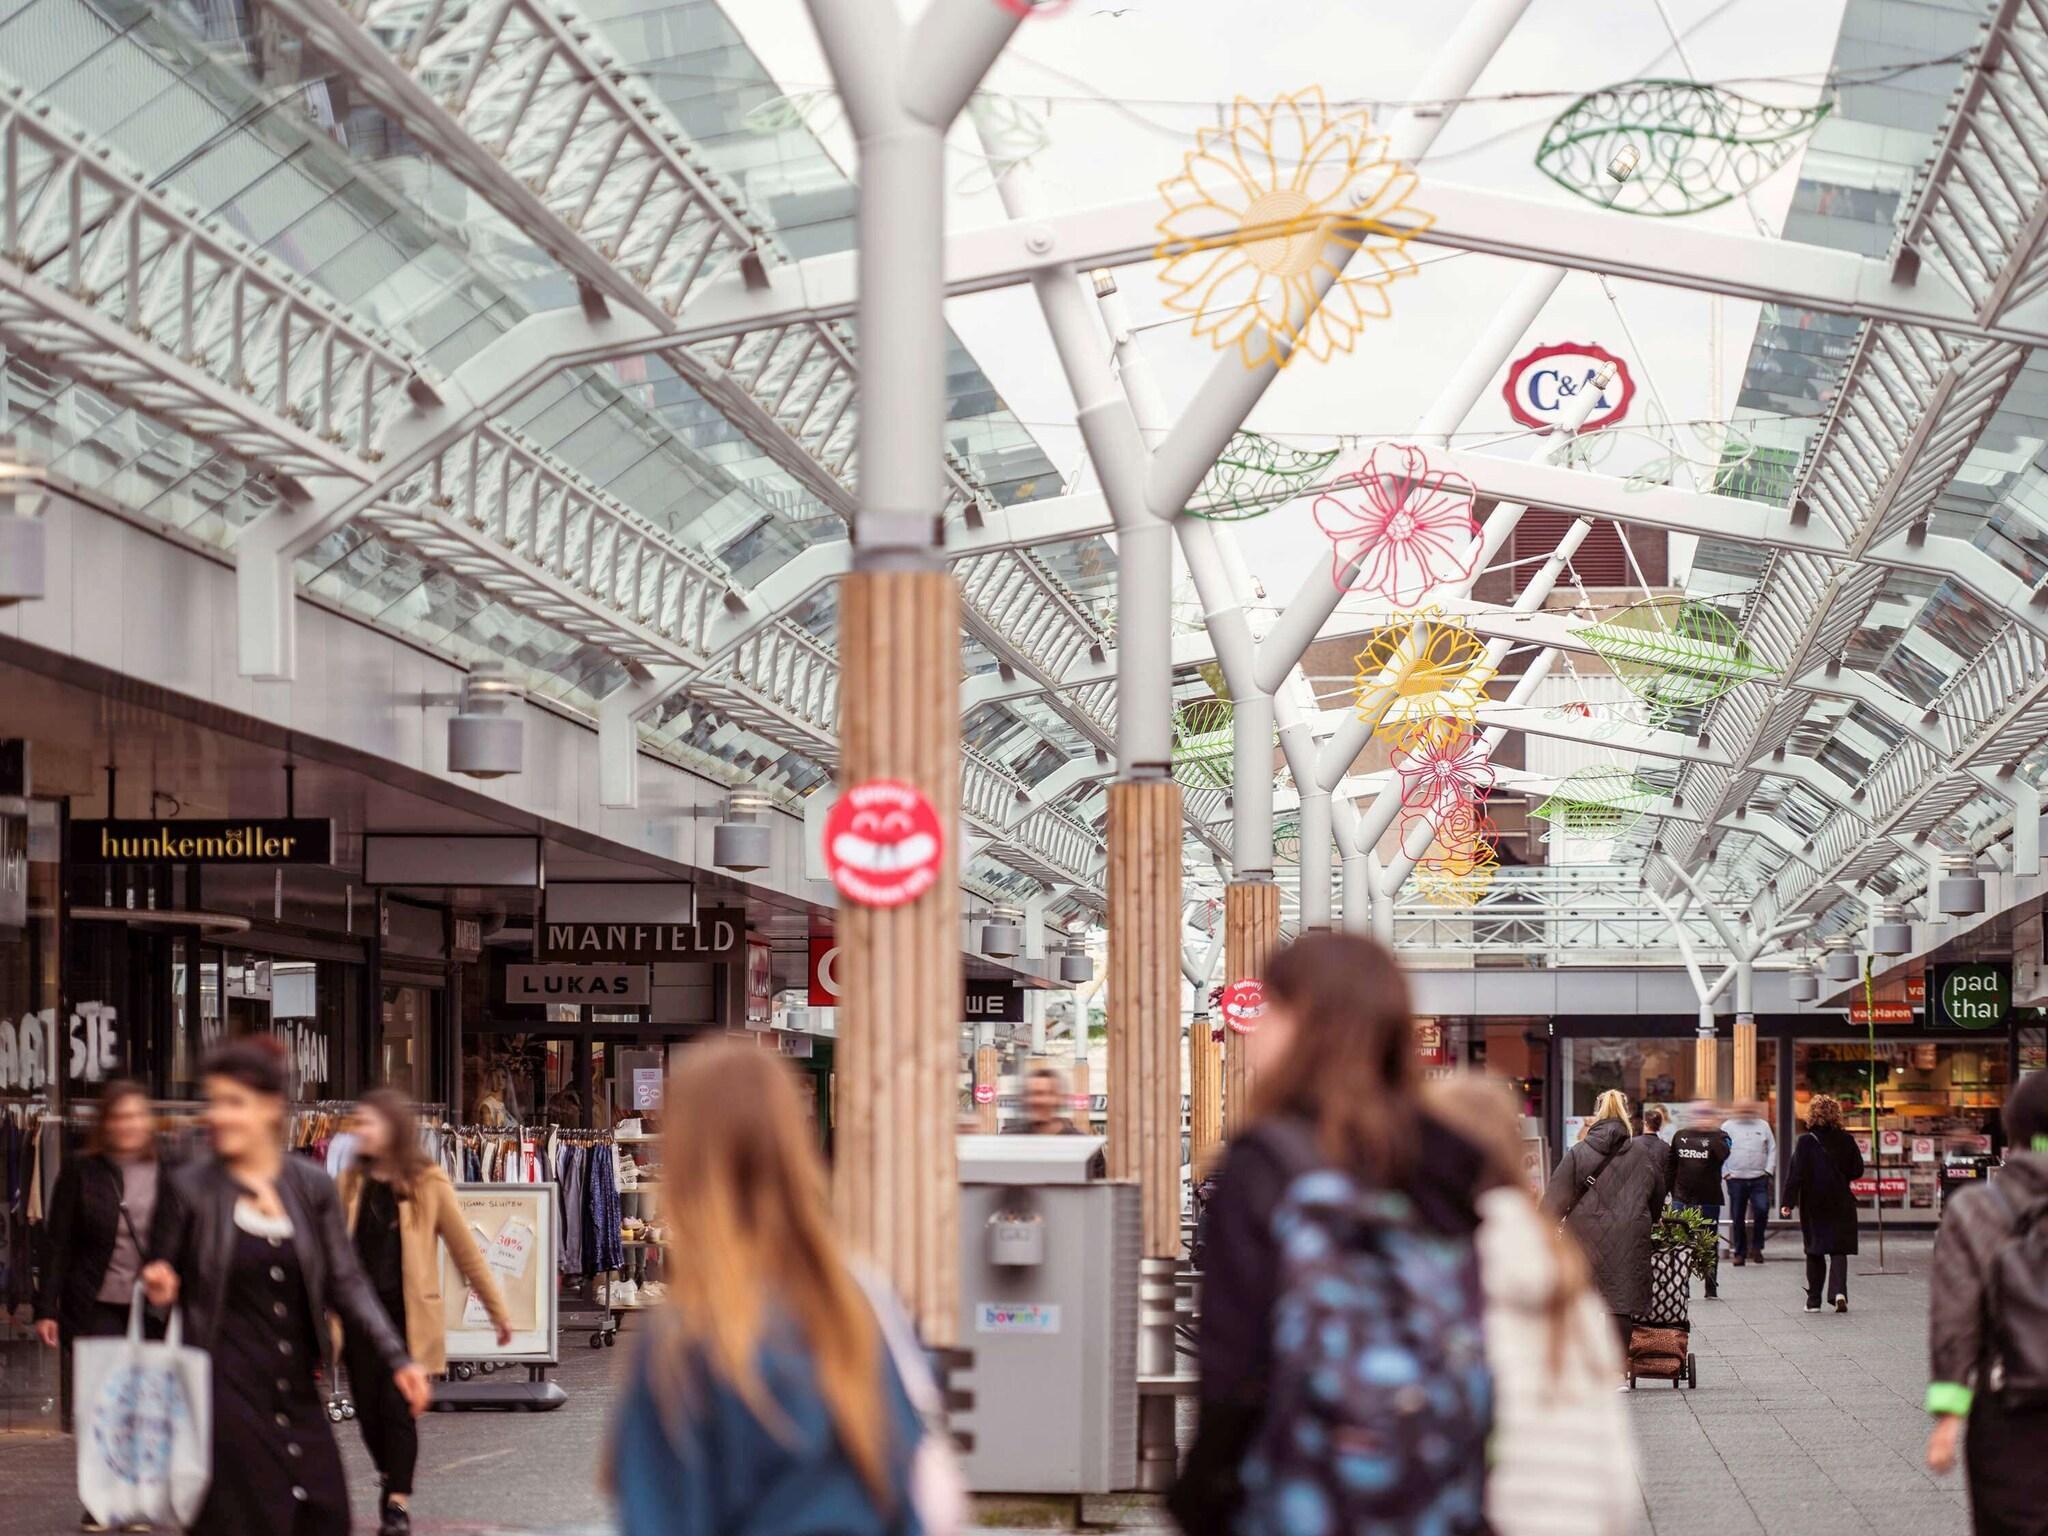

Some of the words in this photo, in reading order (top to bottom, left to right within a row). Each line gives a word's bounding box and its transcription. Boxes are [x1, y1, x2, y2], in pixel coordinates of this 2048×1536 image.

[101, 826, 297, 858] hunkemöller
[549, 920, 735, 951] MANFIELD
[523, 976, 629, 994] LUKAS
[1953, 971, 1998, 996] pad
[966, 995, 1004, 1014] WE
[1952, 998, 1999, 1019] thai
[1678, 1148, 1709, 1159] 32Red
